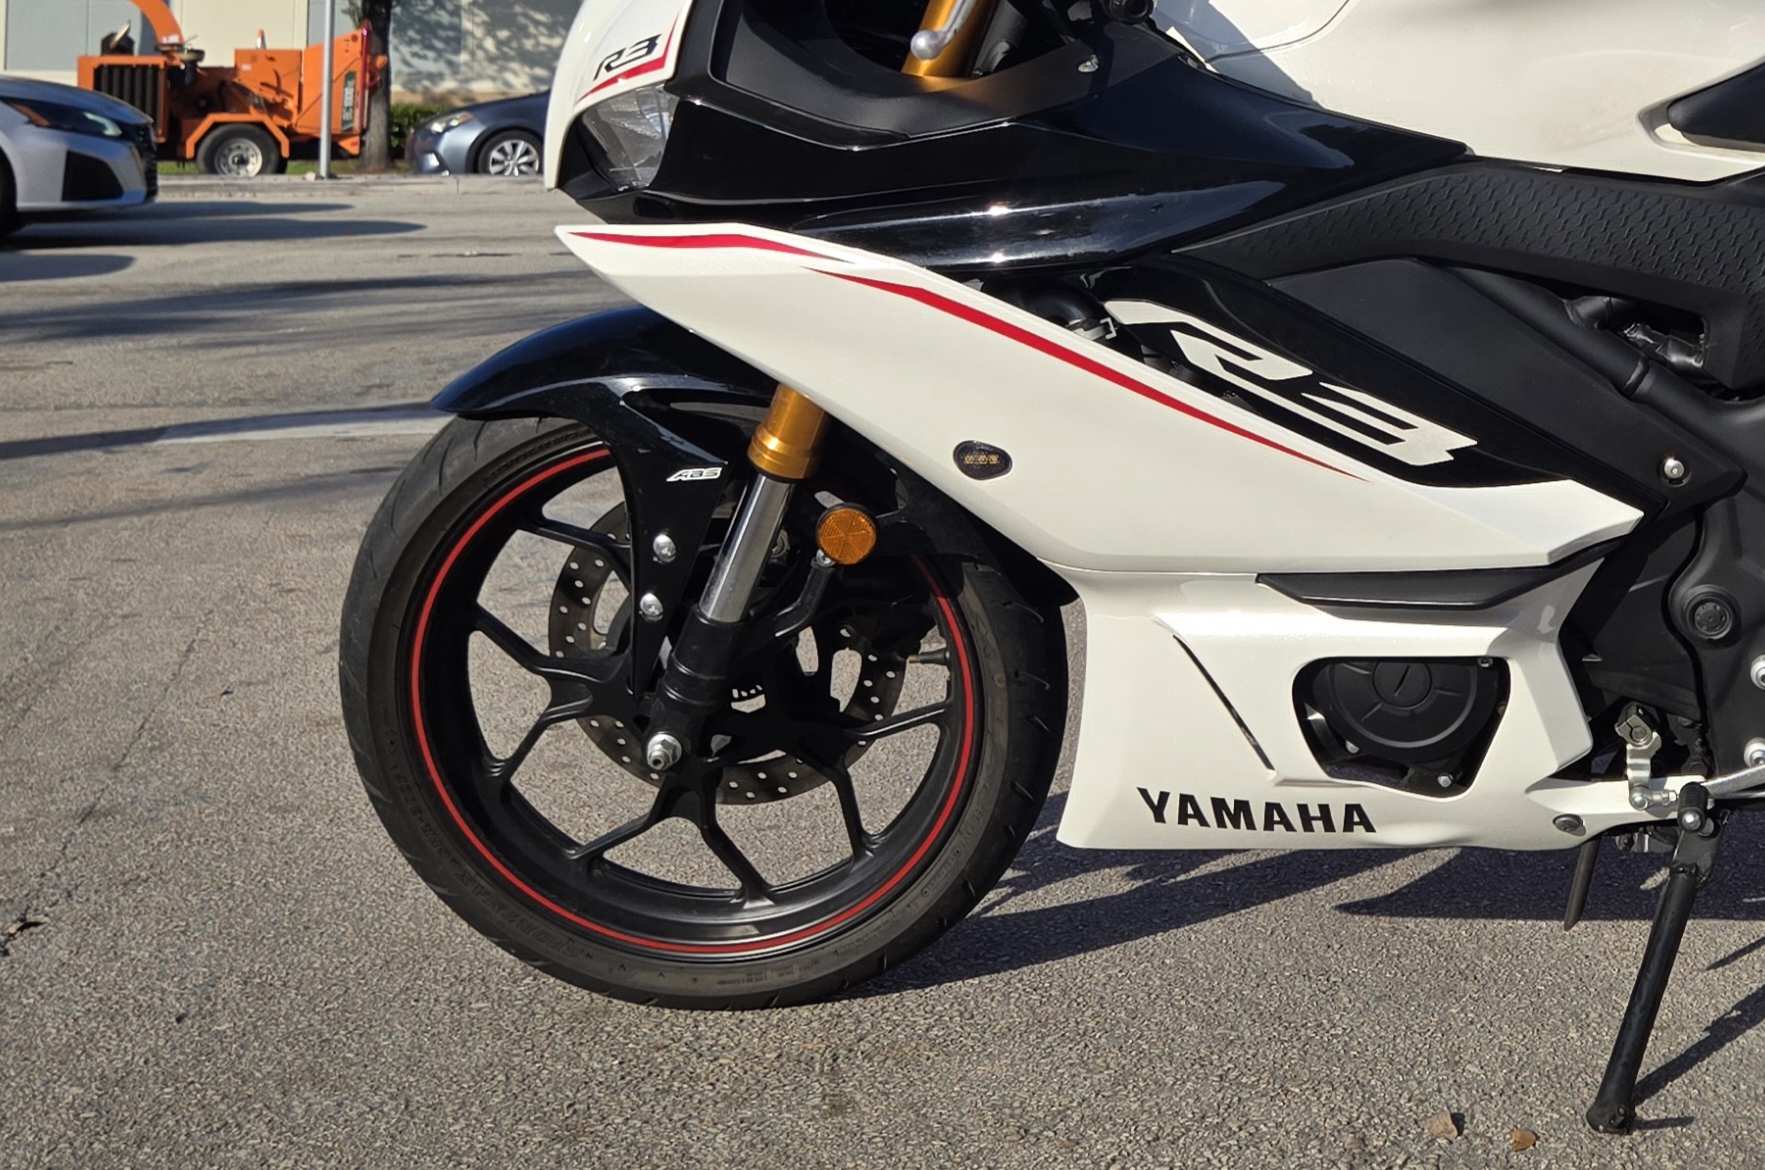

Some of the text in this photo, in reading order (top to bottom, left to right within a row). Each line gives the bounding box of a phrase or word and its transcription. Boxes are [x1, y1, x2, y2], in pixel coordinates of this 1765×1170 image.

[593, 33, 662, 81] R3
[1104, 300, 1478, 466] R3
[666, 467, 722, 482] ABS
[1136, 787, 1377, 834] YAMAHA
